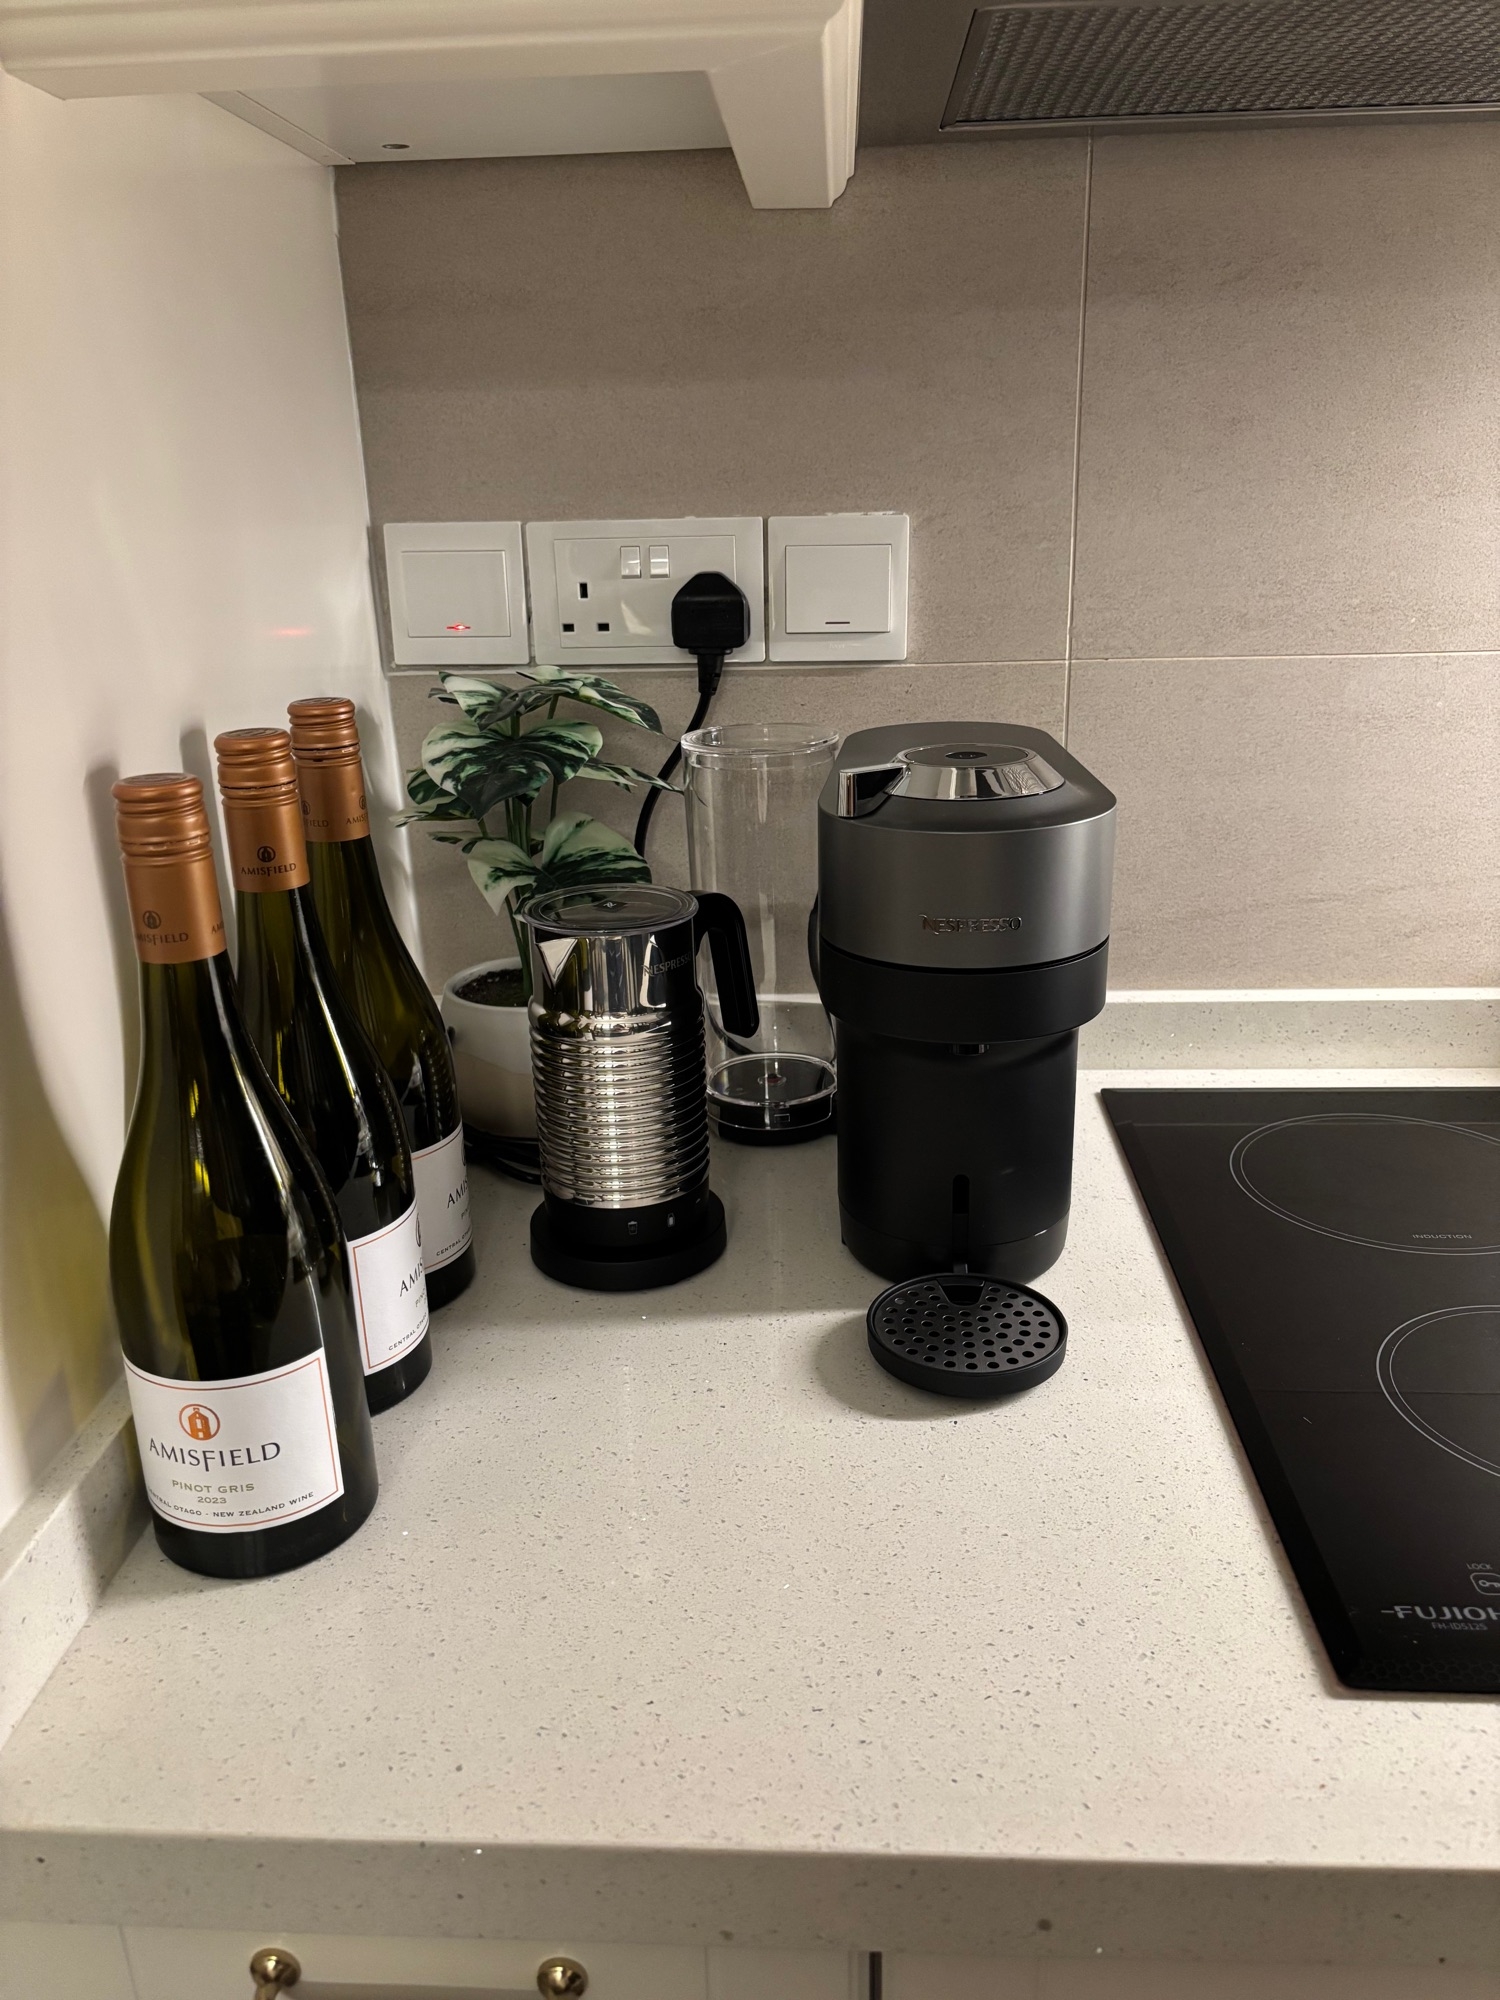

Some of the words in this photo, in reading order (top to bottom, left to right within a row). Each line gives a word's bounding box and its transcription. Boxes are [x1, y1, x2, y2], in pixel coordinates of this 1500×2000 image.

[241, 862, 297, 877] AMISFIELD
[919, 914, 1023, 935] NESPRESSO
[641, 951, 692, 977] NESPRESSO
[388, 1329, 416, 1351] CENTRAL
[149, 1437, 281, 1472] AMISFIELD
[171, 1479, 212, 1494] PINOT
[217, 1483, 256, 1494] GRIS
[173, 1504, 203, 1517] OTAGO
[238, 1502, 286, 1518] ZEALAND
[288, 1490, 315, 1506] WINE
[197, 1495, 228, 1505] 2023
[1466, 1562, 1493, 1570] LOCK
